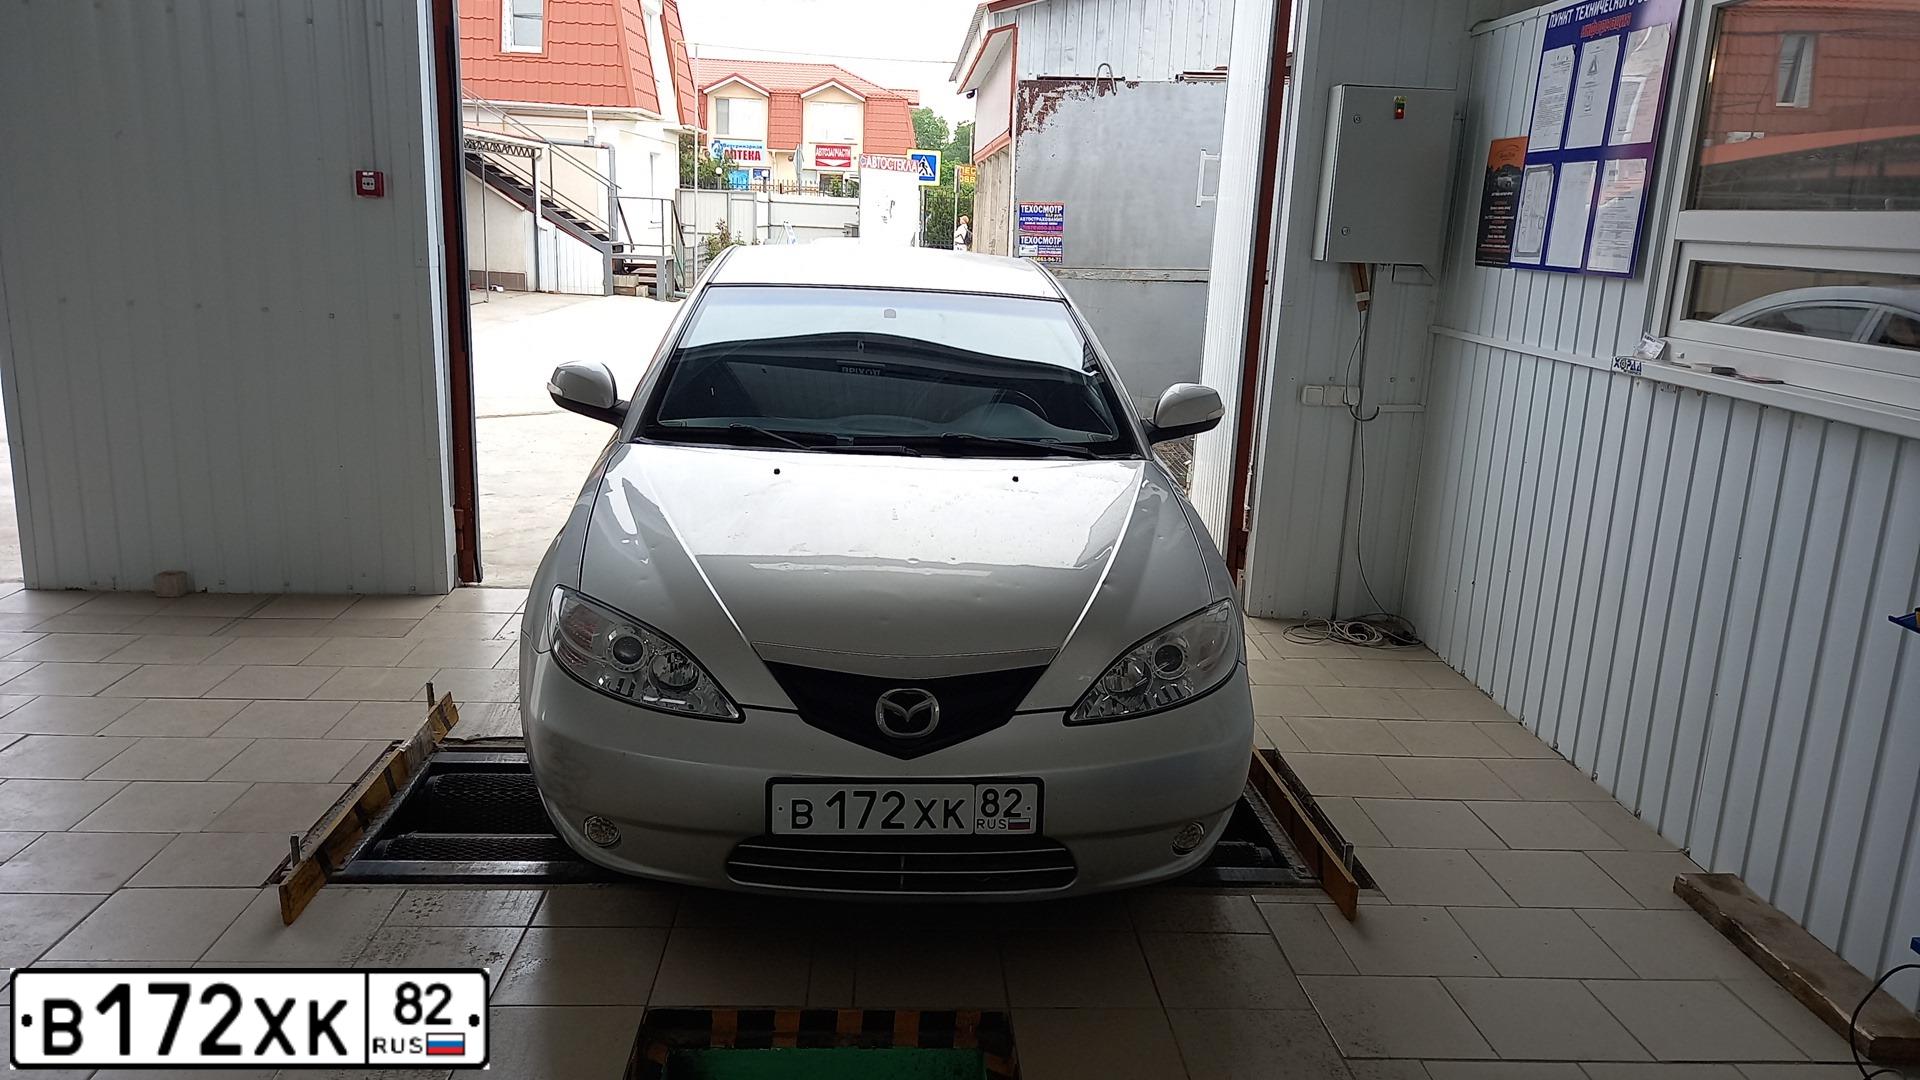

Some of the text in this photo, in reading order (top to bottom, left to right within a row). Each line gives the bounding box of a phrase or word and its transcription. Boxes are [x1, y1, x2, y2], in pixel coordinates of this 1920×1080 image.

[1548, 9, 1575, 29] ПУНКТ
[724, 149, 761, 161] АПТЕКА
[816, 147, 851, 157] АВТОЗАПЧАСТИ
[866, 156, 917, 173] АВТОСТЕКЛА
[1020, 205, 1063, 213] ТЕХОСМОТР
[1020, 236, 1062, 245] ТЕХОСМОТР
[980, 788, 1023, 818] 82
[976, 818, 1007, 830] RUS
